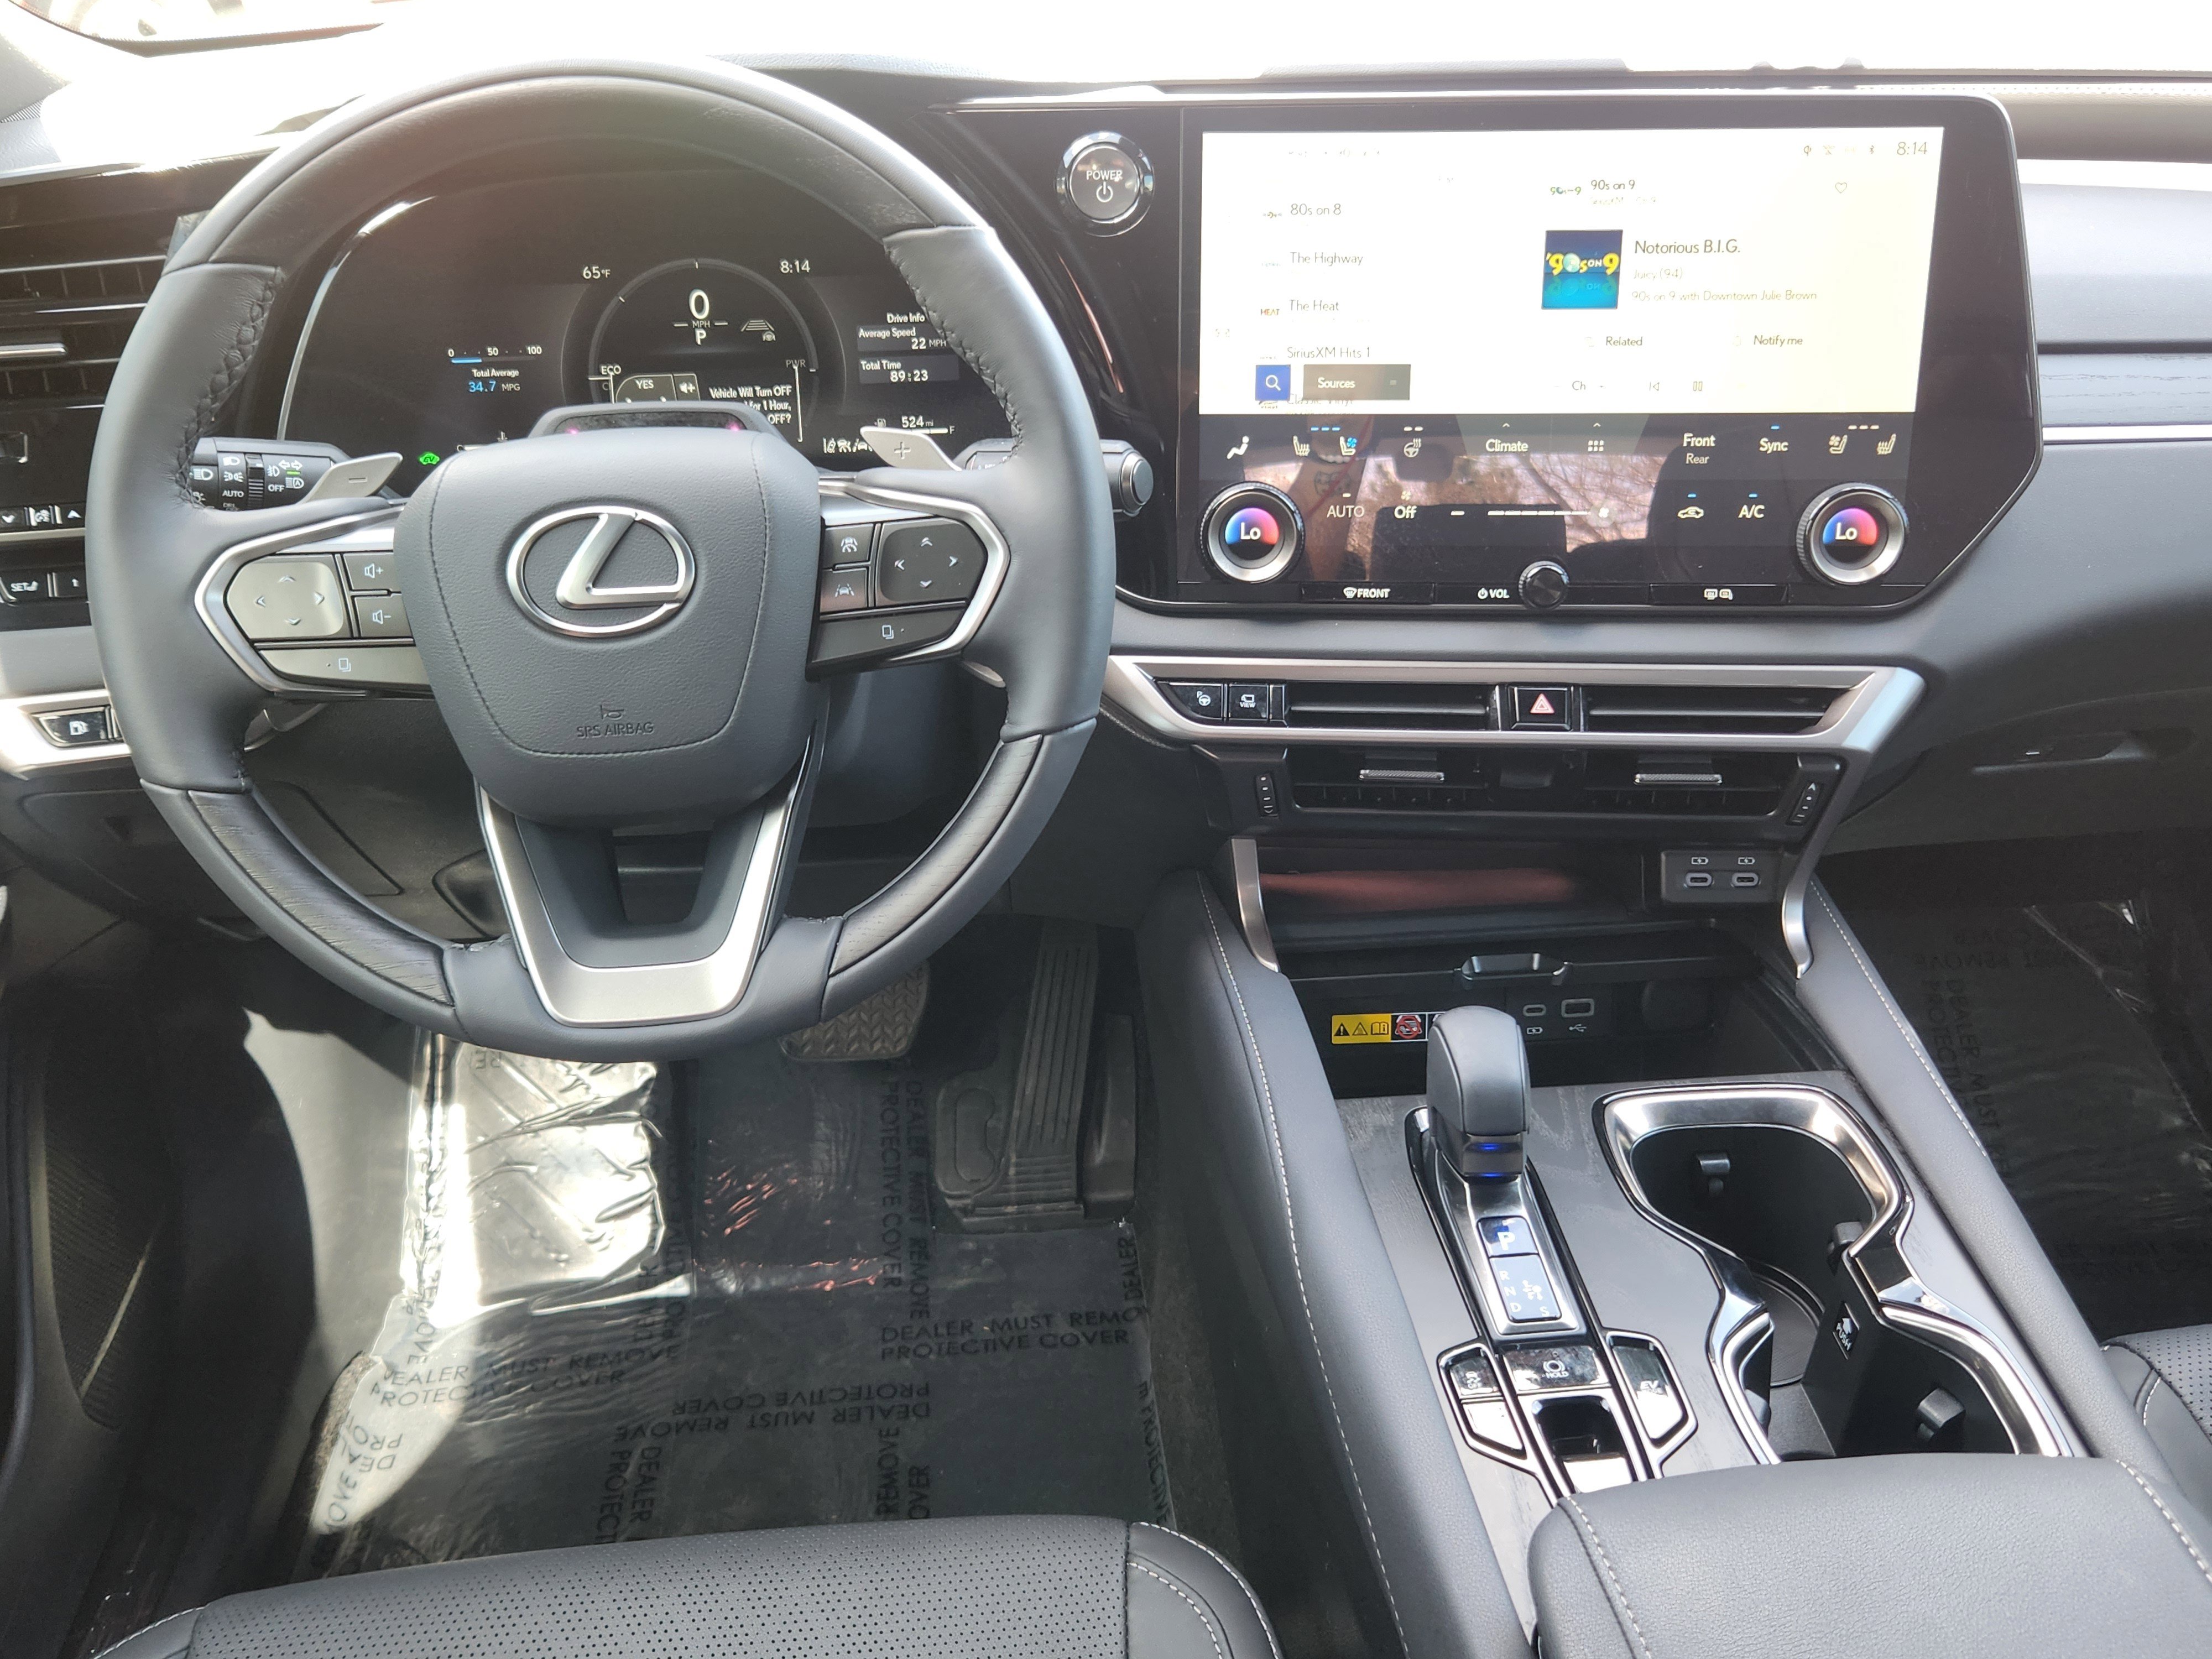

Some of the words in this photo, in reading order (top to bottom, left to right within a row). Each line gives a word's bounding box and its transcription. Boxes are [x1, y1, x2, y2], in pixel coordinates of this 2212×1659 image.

[1896, 141, 1928, 156] 8:14
[1086, 170, 1123, 181] POWER
[1590, 179, 1610, 190] 90s
[1628, 179, 1636, 190] 9
[1290, 203, 1313, 215] 80s
[1316, 206, 1330, 215] on
[1333, 203, 1342, 215] 8
[1634, 240, 1699, 255] Notorious
[1703, 238, 1741, 254] B.I.G.
[780, 259, 811, 273] 8:14
[1290, 252, 1311, 264] The
[1314, 252, 1364, 267] Highway
[1588, 259, 1603, 268] ON
[1603, 252, 1620, 276] 9
[1660, 267, 1683, 280] (94)
[1631, 290, 1650, 301] 90s
[1669, 290, 1676, 301] 9
[1679, 291, 1699, 300] with
[1703, 289, 1757, 300] Downtown
[1761, 289, 1782, 300] Julie
[1785, 289, 1817, 300] Brown
[689, 289, 709, 320] 0
[1289, 299, 1310, 311] The
[1313, 300, 1339, 311] Heat
[887, 312, 909, 323] Drive
[909, 312, 925, 322] Info
[695, 328, 707, 345] P
[859, 328, 890, 339] Average
[891, 326, 916, 338] Speed
[911, 337, 926, 349] 22
[928, 339, 947, 347] MPH
[1605, 336, 1642, 346] Related
[1753, 335, 1786, 347] Notify
[448, 348, 455, 357] 0
[486, 347, 499, 357] 50
[527, 345, 542, 355] 100
[1286, 346, 1336, 358] SiriusXM
[1339, 347, 1362, 358] Hits
[1366, 346, 1370, 358] 1
[601, 364, 622, 375] ECO
[786, 359, 806, 368] PWR
[860, 361, 880, 370] Total
[882, 360, 901, 369] Time
[472, 369, 490, 377] Total
[491, 369, 519, 378] Average
[469, 380, 497, 392] 34.7
[502, 383, 520, 392] MPG
[635, 379, 654, 389] YES
[1318, 377, 1355, 389] Sources
[1572, 380, 1587, 391] Ch
[709, 387, 738, 399] Vehicle
[738, 386, 754, 398] Will
[754, 385, 773, 397] Turn
[774, 384, 792, 397] OFF
[768, 414, 791, 424] OFF?
[901, 416, 924, 428] 524
[950, 426, 955, 434] F
[1486, 439, 1528, 452] Climate
[1683, 433, 1715, 447] Front
[1760, 437, 1788, 452] Sync
[1686, 453, 1709, 463] Rear
[1327, 506, 1364, 518] AUTO
[1394, 505, 1417, 519] Off
[1739, 504, 1765, 519] A/C
[1240, 523, 1261, 540] Lo
[1835, 522, 1858, 540] Lo
[11, 582, 29, 592] SET
[1357, 588, 1390, 599] FRONT
[1489, 589, 1510, 599] VOL
[577, 725, 601, 738] SRS
[605, 722, 654, 737] AIRBAG
[880, 1080, 901, 1207] PROTECTIVE
[1498, 1232, 1516, 1251] P
[883, 1213, 902, 1288] COVER
[1117, 1235, 1144, 1302] DEALER
[909, 1236, 930, 1319] REMOVE
[881, 1319, 974, 1344] DEALER
[990, 1313, 1055, 1334] MUST
[1836, 1321, 1851, 1351] PUSH
[881, 1334, 1032, 1360] PROTECTIVE
[1038, 1329, 1130, 1349] COVER
[774, 1382, 930, 1406] PROTECTIVE
[672, 1392, 766, 1416] COVER
[832, 1401, 930, 1424] DEALER
[747, 1410, 815, 1430] MUST
[613, 1415, 729, 1443] REMOVE
[875, 1427, 900, 1515] REMOVE
[629, 1446, 662, 1524] DEALER
